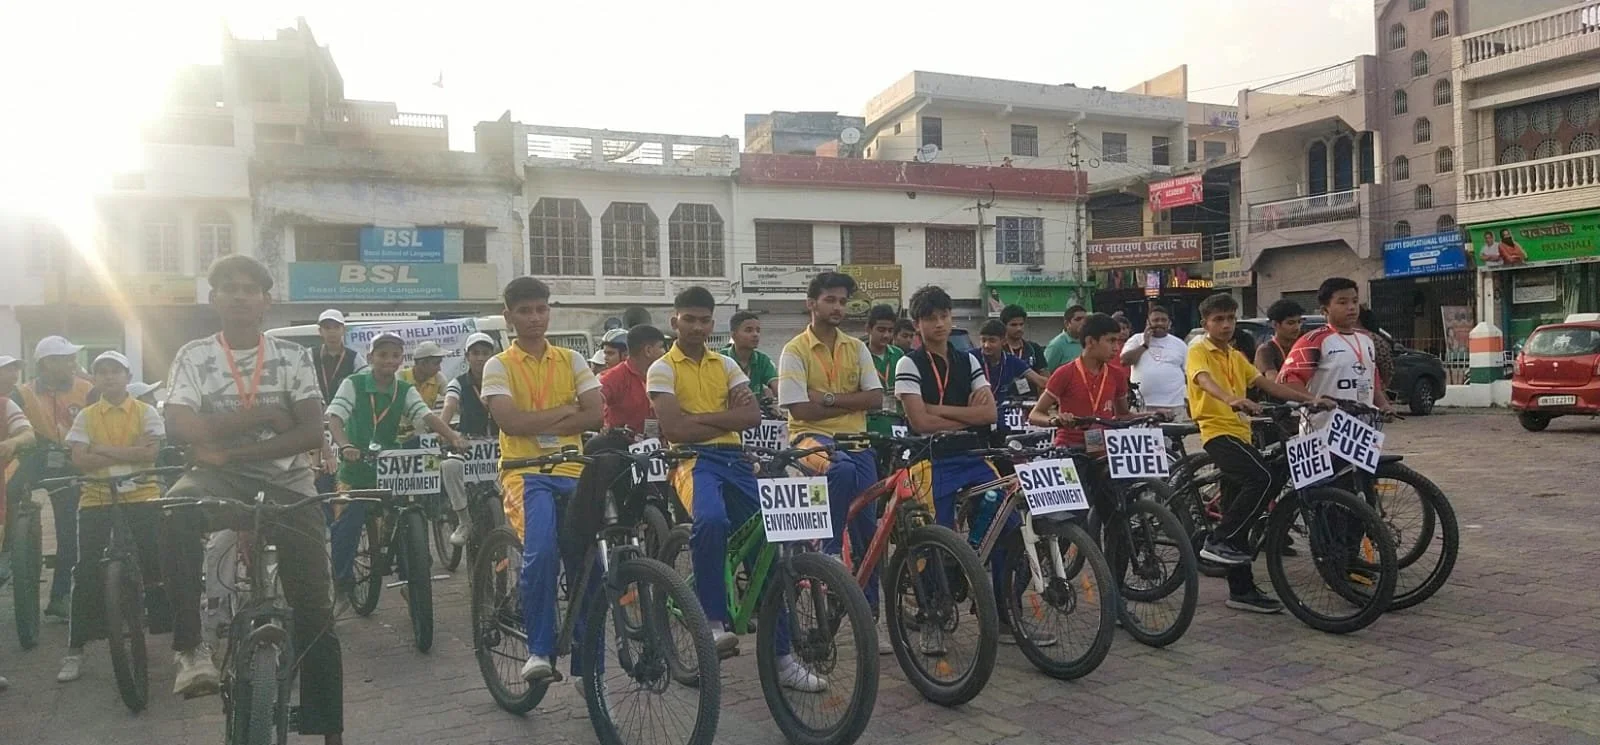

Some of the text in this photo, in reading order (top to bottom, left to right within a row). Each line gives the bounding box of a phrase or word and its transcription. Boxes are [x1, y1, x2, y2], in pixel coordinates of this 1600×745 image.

[1166, 186, 1186, 197] ACADEMY
[383, 229, 423, 247] BSL
[1105, 241, 1142, 254] नारायण
[1179, 238, 1198, 249] राय
[1403, 237, 1438, 249] EDUCATIONAL
[410, 249, 440, 258] Languages
[339, 264, 419, 284] BSL
[389, 286, 443, 295] Languages
[858, 278, 899, 292] rjeeling
[350, 329, 403, 343] PROT
[406, 327, 434, 338] HELP
[437, 323, 470, 336] INDIA
[744, 425, 778, 441] SAVE
[1331, 413, 1373, 447] SAVE
[463, 443, 500, 460] SAVE
[1107, 435, 1155, 455] SAVE
[1288, 437, 1318, 464] SAVE
[1328, 430, 1376, 470] FUEL
[378, 455, 423, 475] SAVE
[464, 462, 498, 475] ENVIRON
[1110, 455, 1168, 475] FUEL
[1292, 454, 1331, 483] FUEL
[378, 475, 439, 491] ENVIRONMENT
[1019, 466, 1065, 491] SAVE
[760, 483, 810, 510] SAVE
[1027, 488, 1084, 509] ENVIRONMENT
[764, 511, 829, 532] ENVIRONMENT
